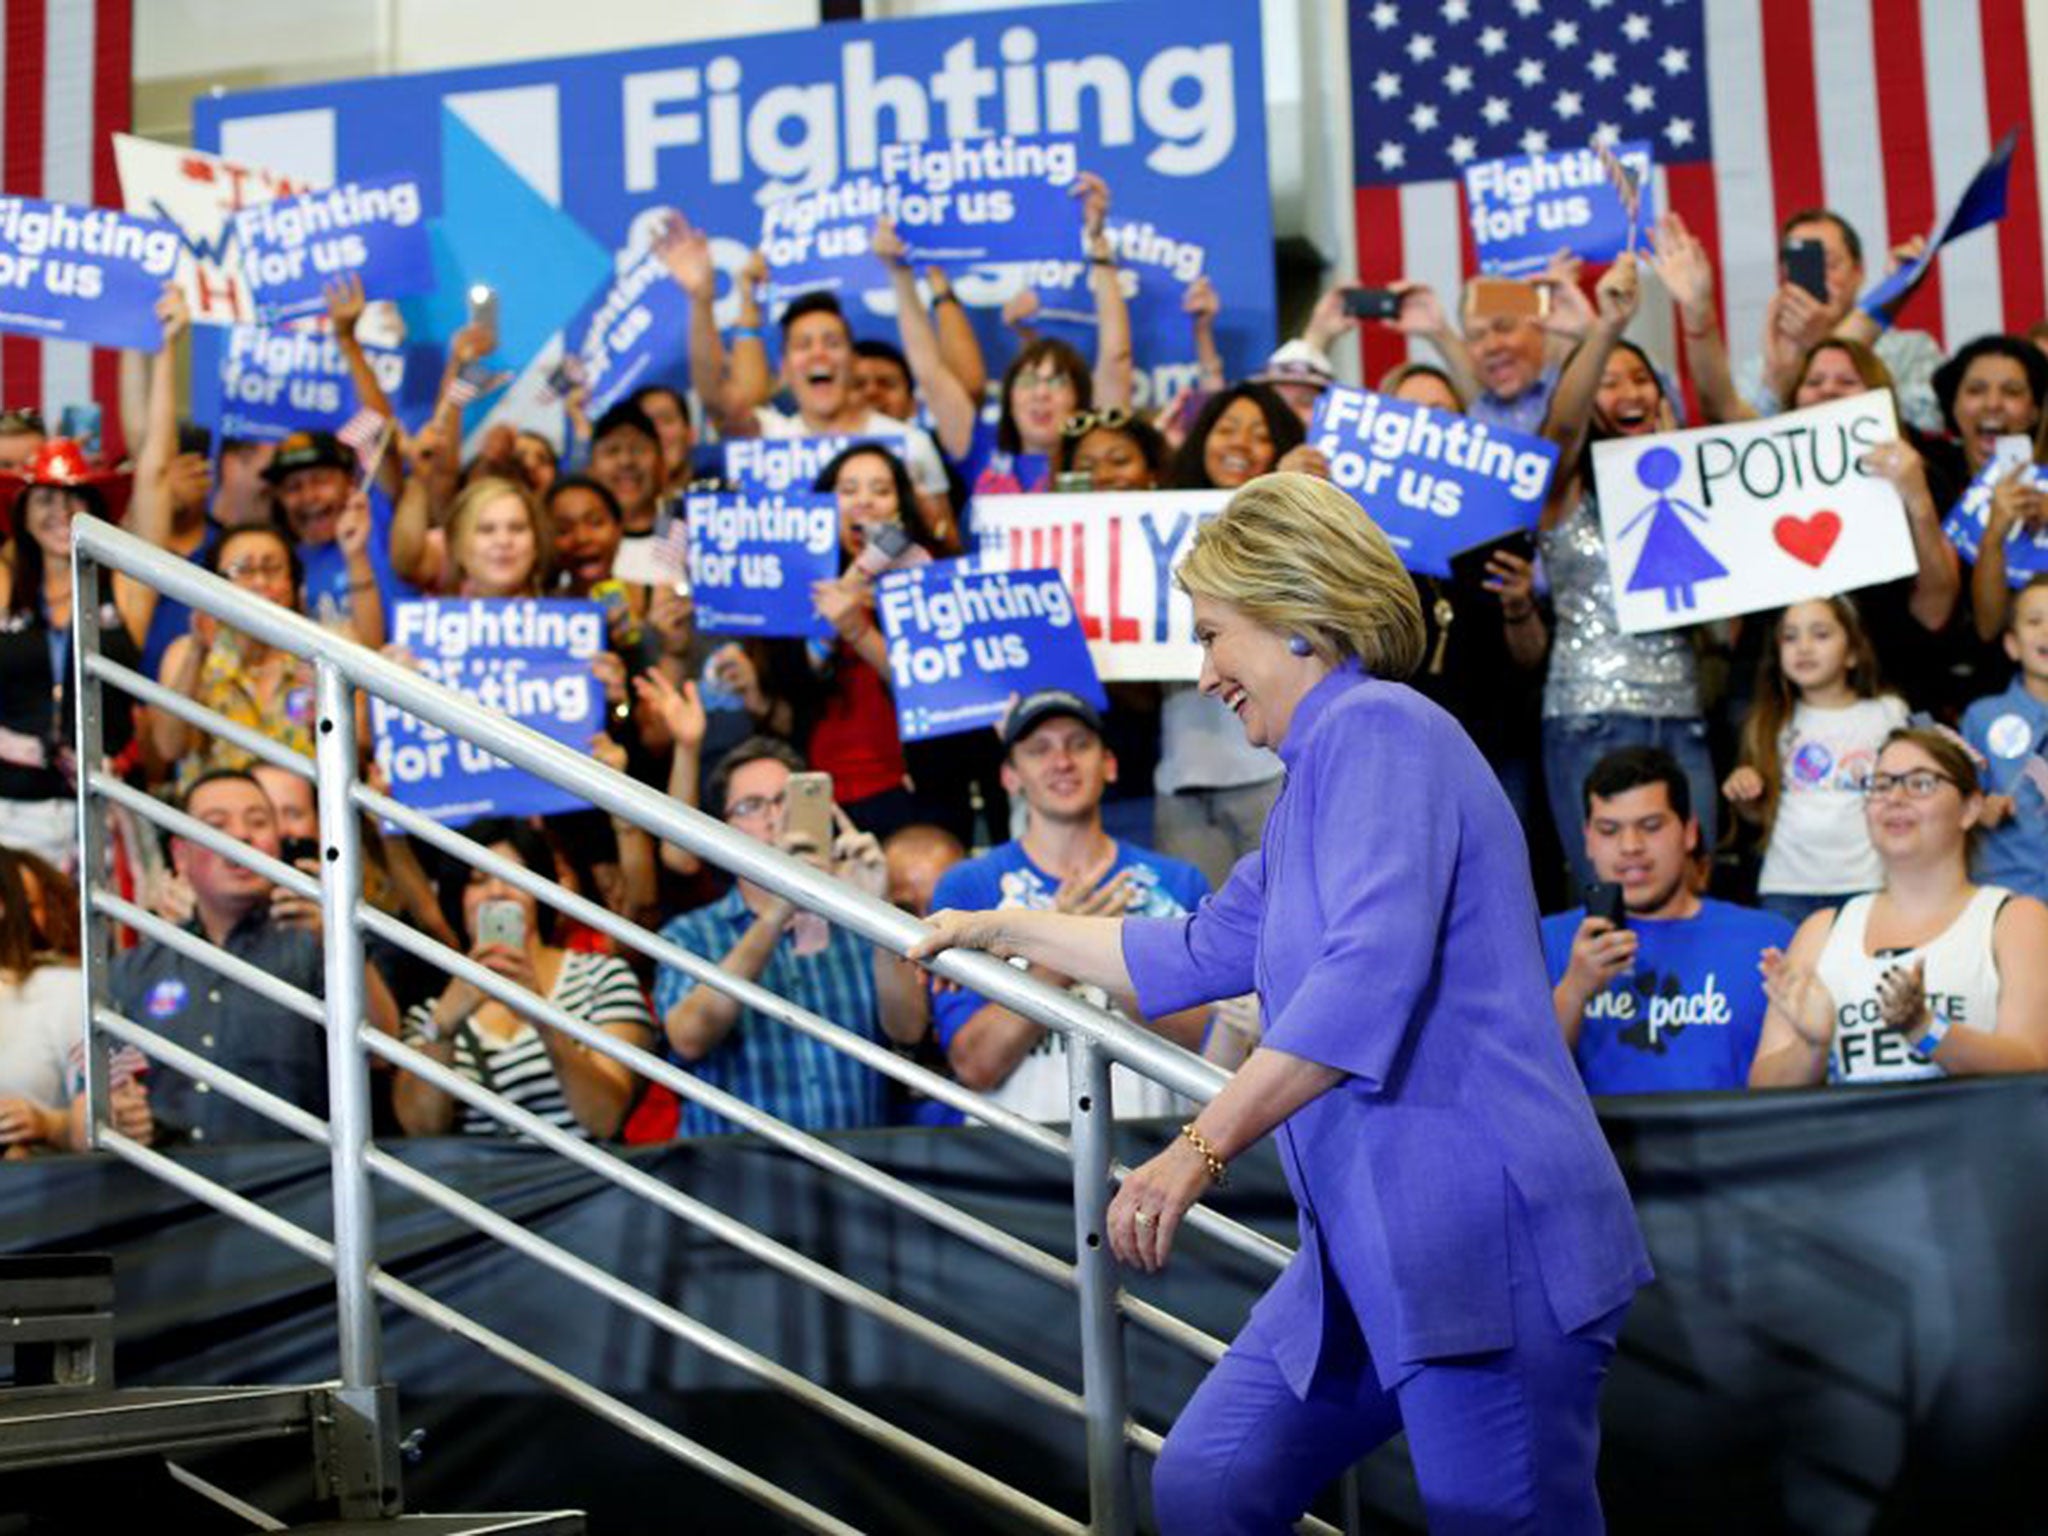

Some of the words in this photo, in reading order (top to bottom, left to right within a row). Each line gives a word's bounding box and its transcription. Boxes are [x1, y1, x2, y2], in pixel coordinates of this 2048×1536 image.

[623, 26, 1237, 210] Fighting
[881, 137, 1077, 192] Fighting
[235, 181, 422, 251] Fighting
[956, 190, 1015, 225] us
[1472, 201, 1532, 245] for
[1536, 196, 1592, 231] us
[0, 197, 179, 276] ighting
[245, 245, 306, 289] for
[310, 233, 368, 274] us
[816, 223, 868, 260] us
[44, 259, 104, 299] us
[289, 376, 341, 414] us
[1323, 386, 1551, 502] Fighting
[1696, 415, 1886, 508] POTUS
[1396, 467, 1465, 518] us
[687, 494, 836, 555] Fighting
[688, 541, 738, 588] for
[739, 553, 783, 589] us
[394, 600, 602, 659] Fighting
[881, 574, 1073, 641] Fighting
[890, 636, 968, 688] for
[972, 633, 1030, 672] us
[1649, 973, 1733, 1045] pack
